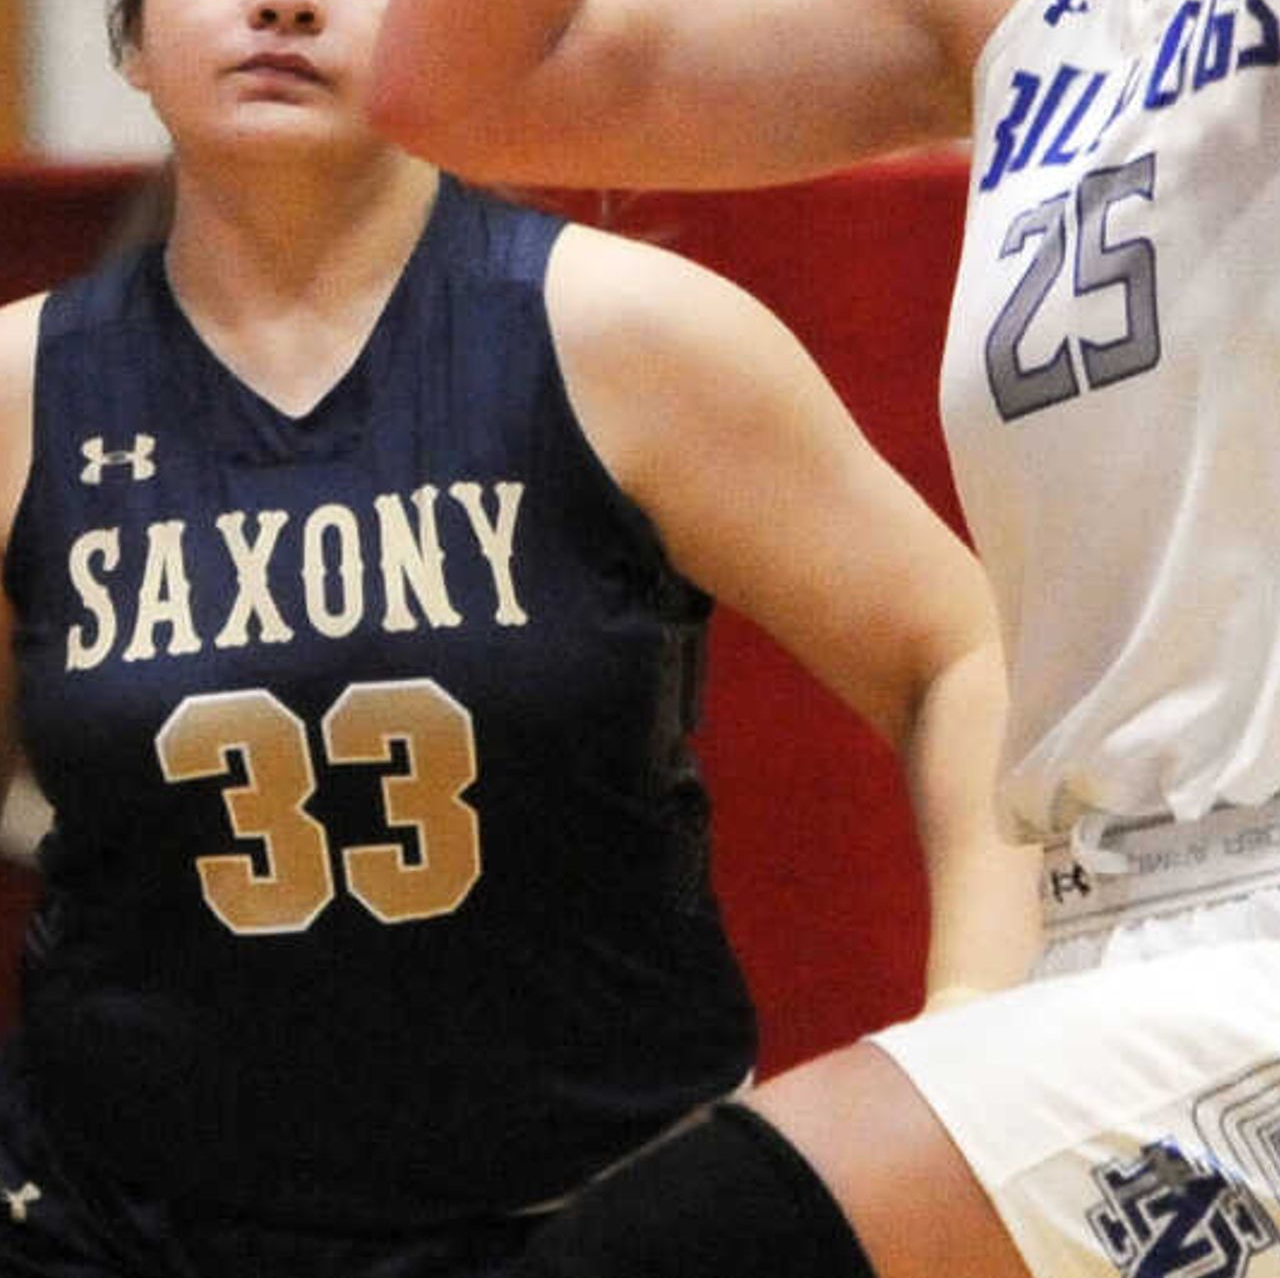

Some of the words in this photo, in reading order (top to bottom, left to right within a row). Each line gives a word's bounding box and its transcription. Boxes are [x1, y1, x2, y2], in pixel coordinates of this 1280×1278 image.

[984, 152, 1162, 423] 25
[65, 481, 528, 672] SAXONY
[154, 678, 481, 935] 33
